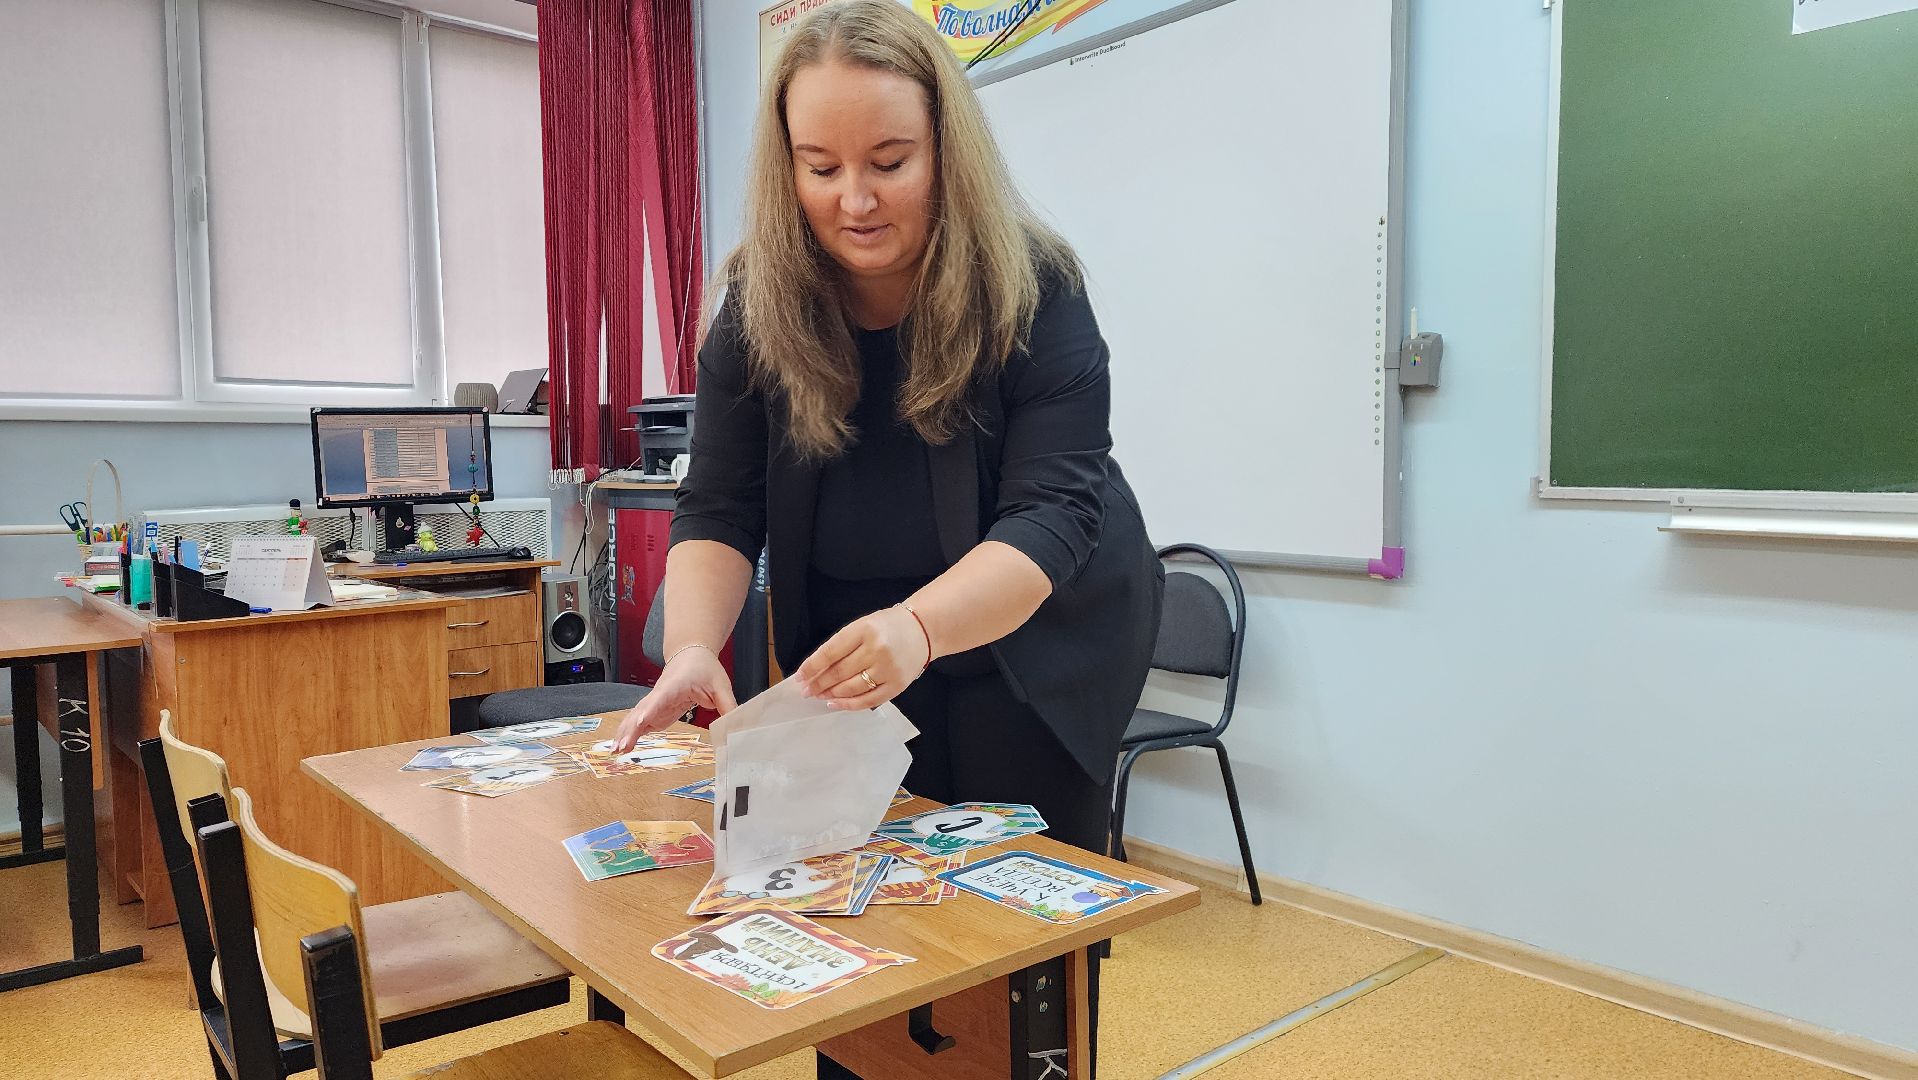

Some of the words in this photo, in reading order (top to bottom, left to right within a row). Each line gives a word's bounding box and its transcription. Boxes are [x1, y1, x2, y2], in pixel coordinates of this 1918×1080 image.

[770, 6, 796, 26] СИДИ
[607, 507, 617, 621] INFORCE
[994, 867, 1067, 893] ВСЕГДА
[740, 915, 855, 969] ЗНАНИЙ
[743, 937, 815, 971] ДЕНЬ
[710, 952, 797, 987] СЕНТЯБРЯ
